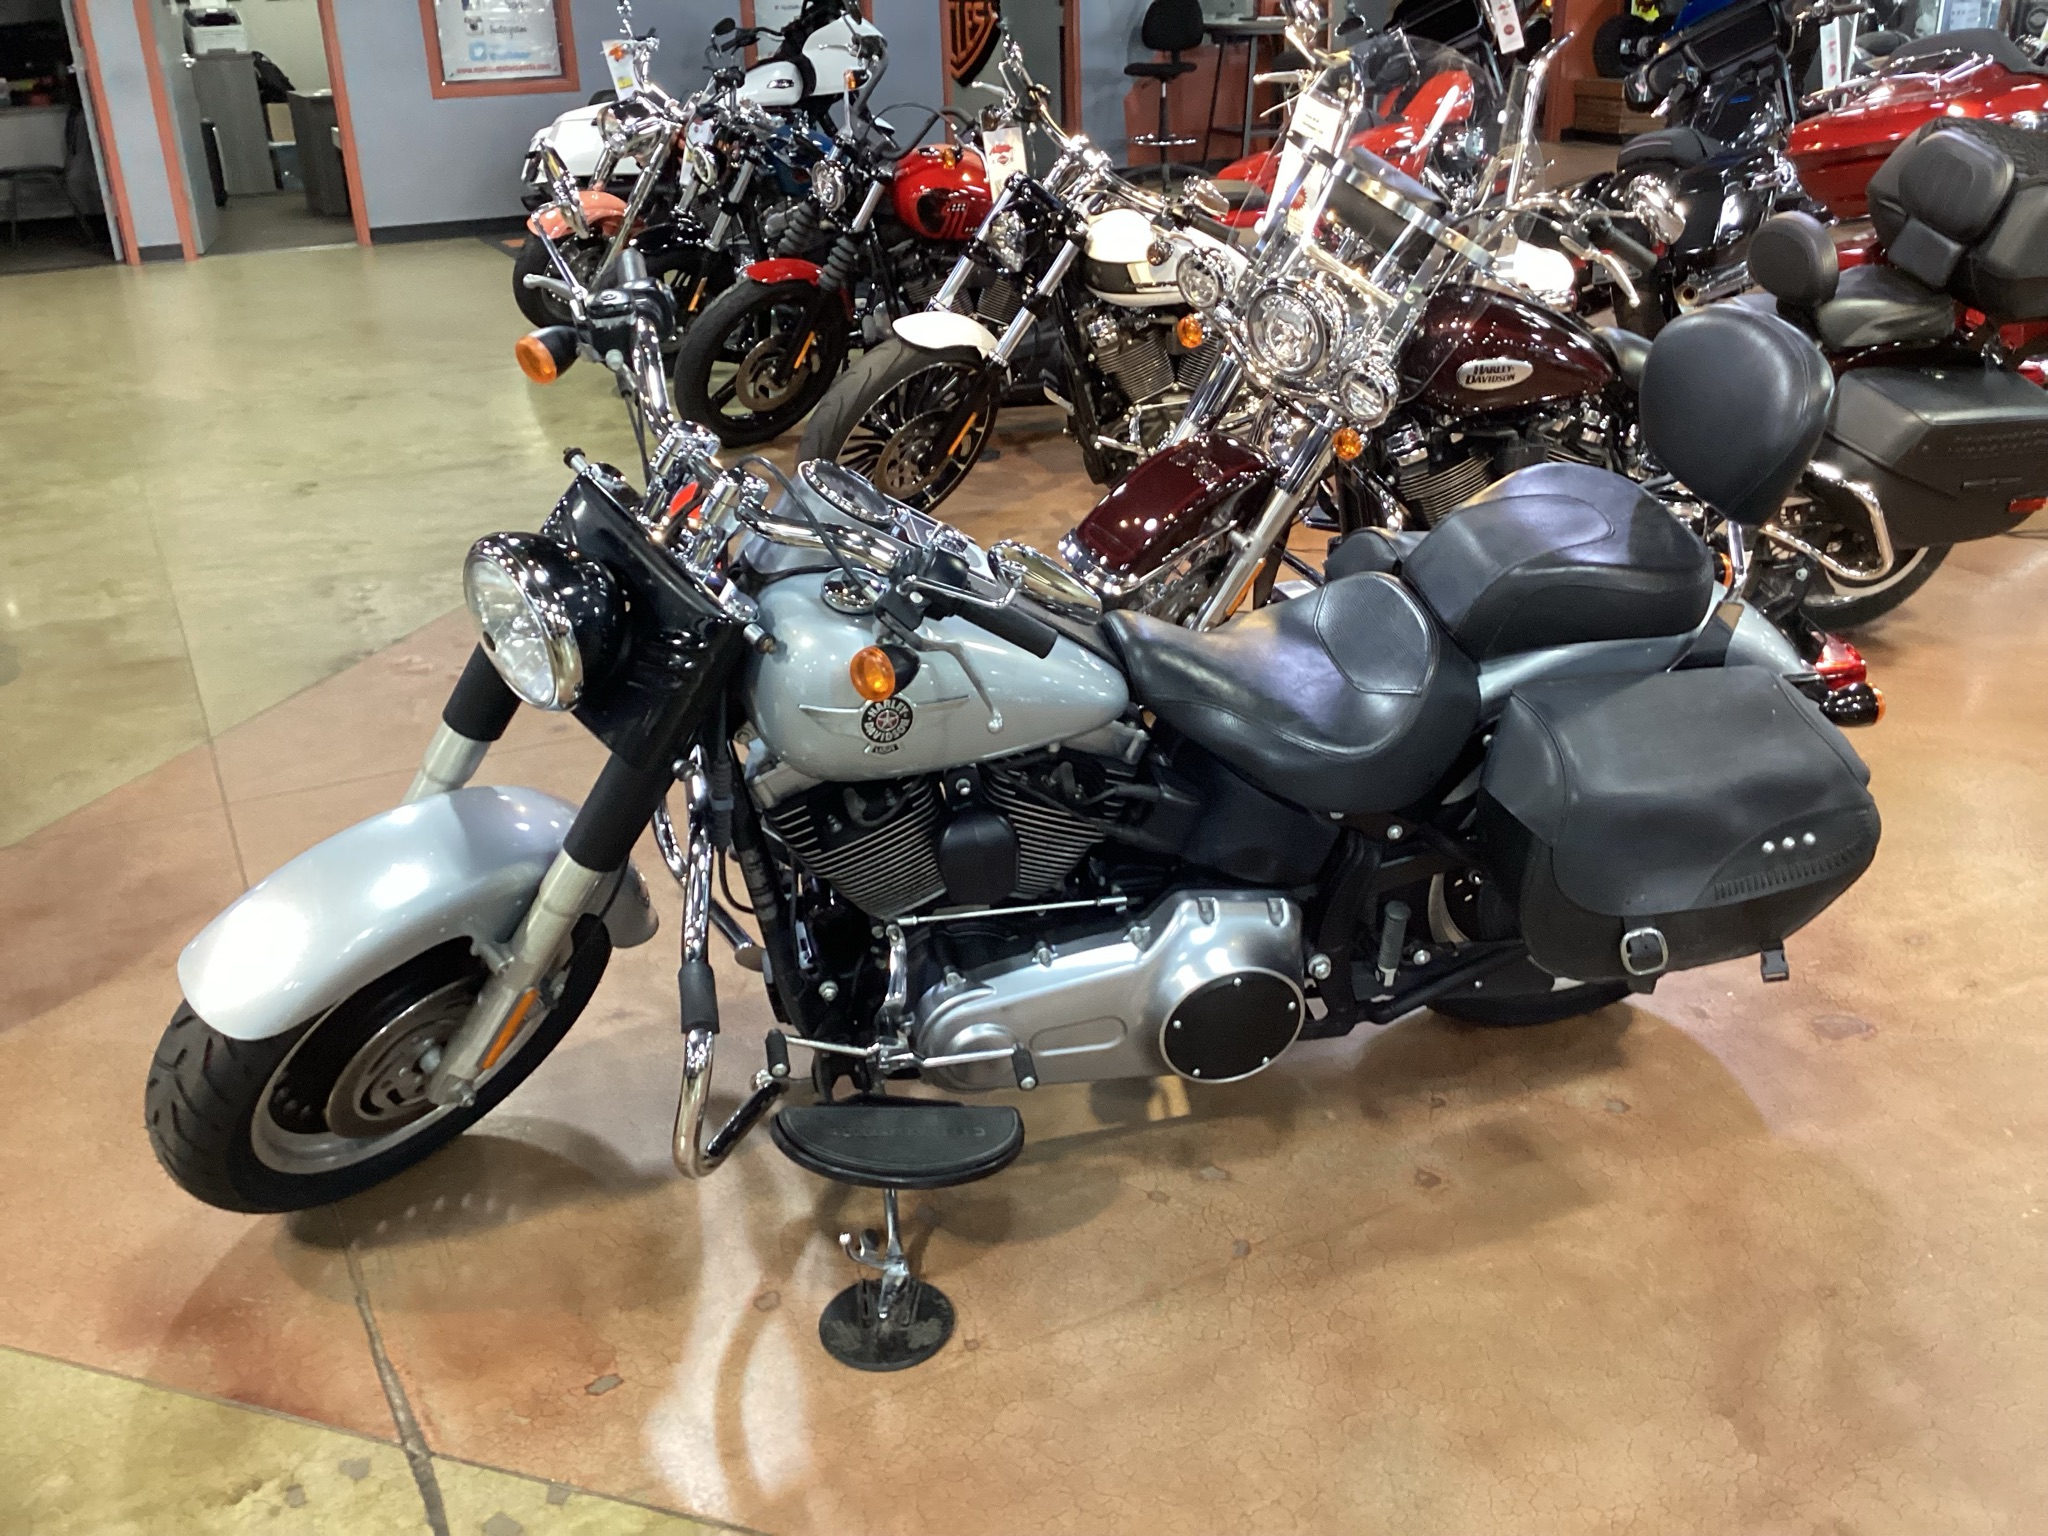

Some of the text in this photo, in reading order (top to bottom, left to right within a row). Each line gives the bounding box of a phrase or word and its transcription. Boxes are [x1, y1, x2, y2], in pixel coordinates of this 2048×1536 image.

[1465, 374, 1516, 384] DAVIDSON
[867, 699, 909, 718] HARLEY
[864, 718, 910, 742] DAVIDSON
